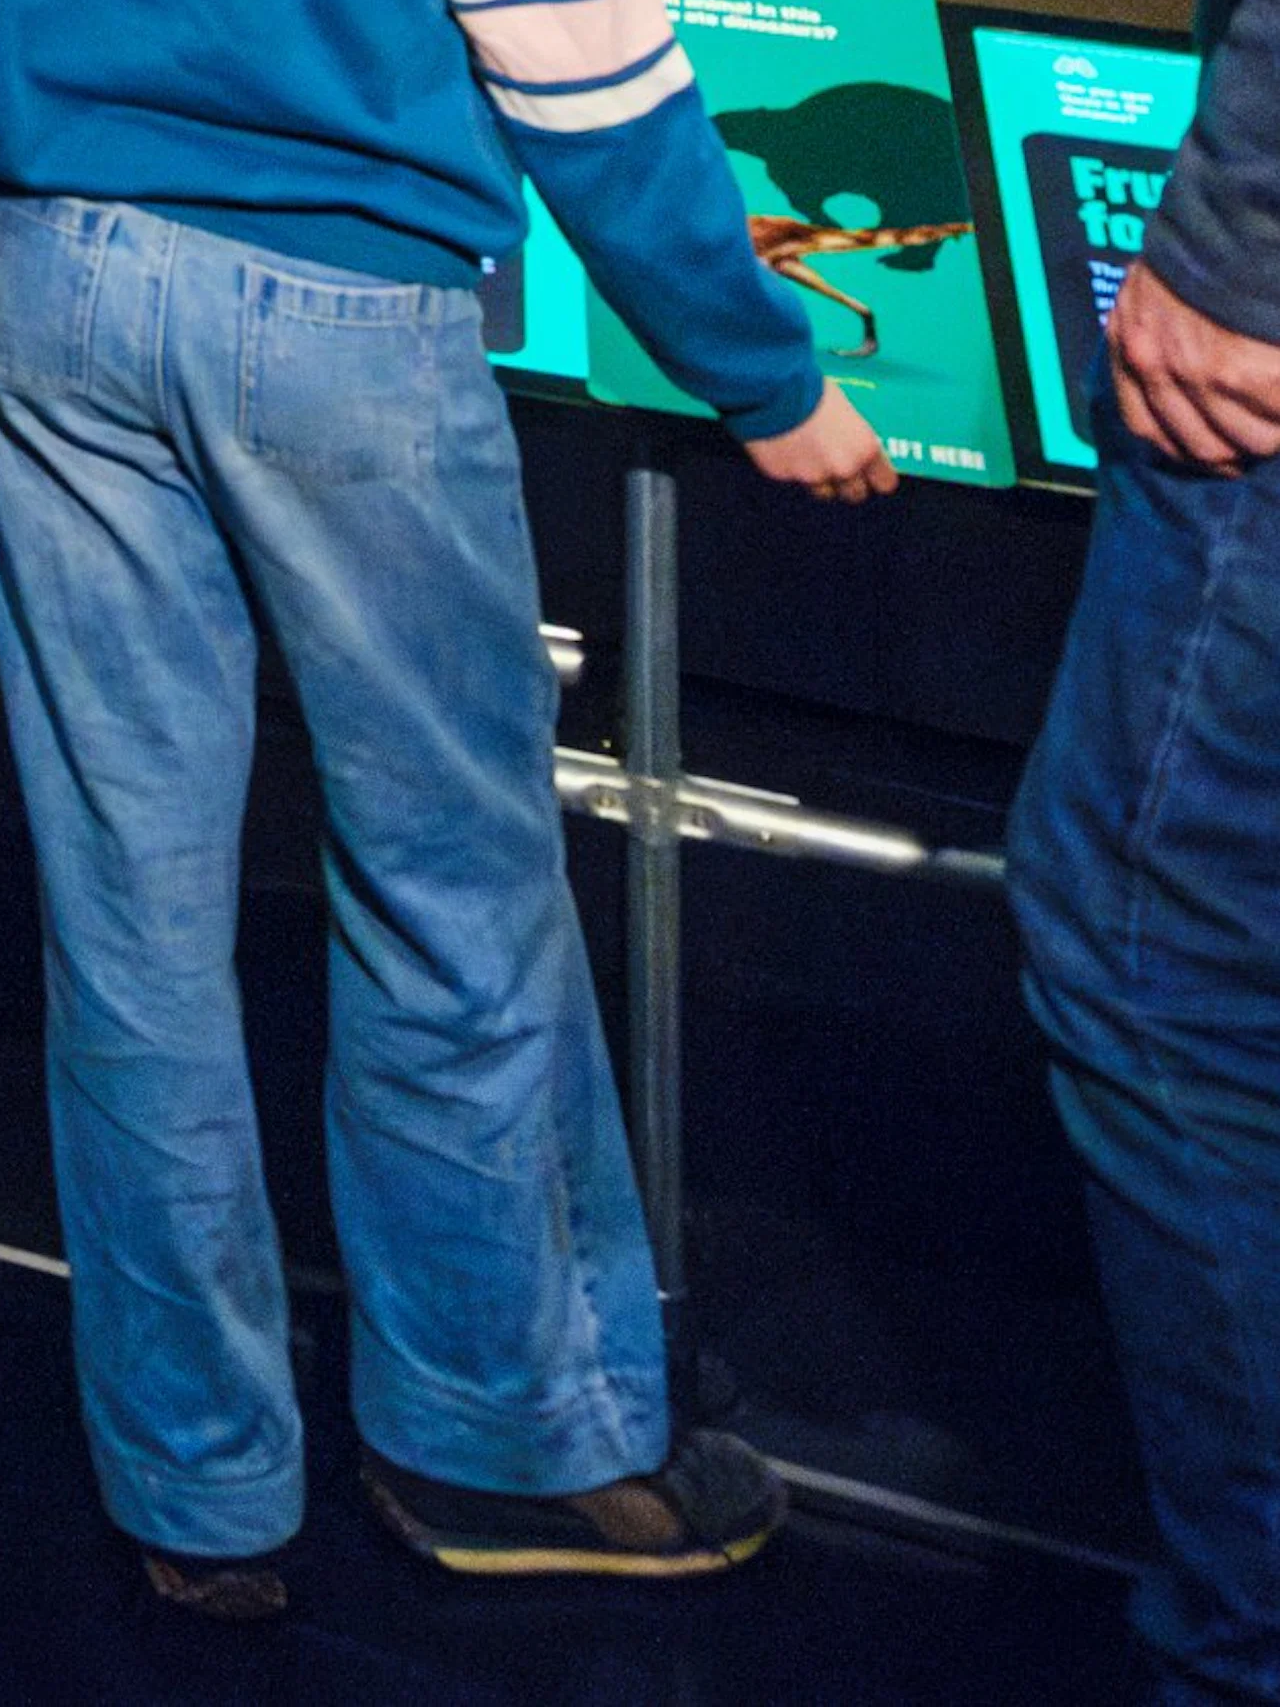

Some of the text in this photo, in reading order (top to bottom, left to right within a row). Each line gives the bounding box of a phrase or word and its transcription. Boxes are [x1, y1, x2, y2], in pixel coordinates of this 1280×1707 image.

[755, 2, 777, 18] in
[780, 6, 822, 24] this
[721, 15, 838, 40] dinosaurs?
[1070, 155, 1173, 209] Fru
